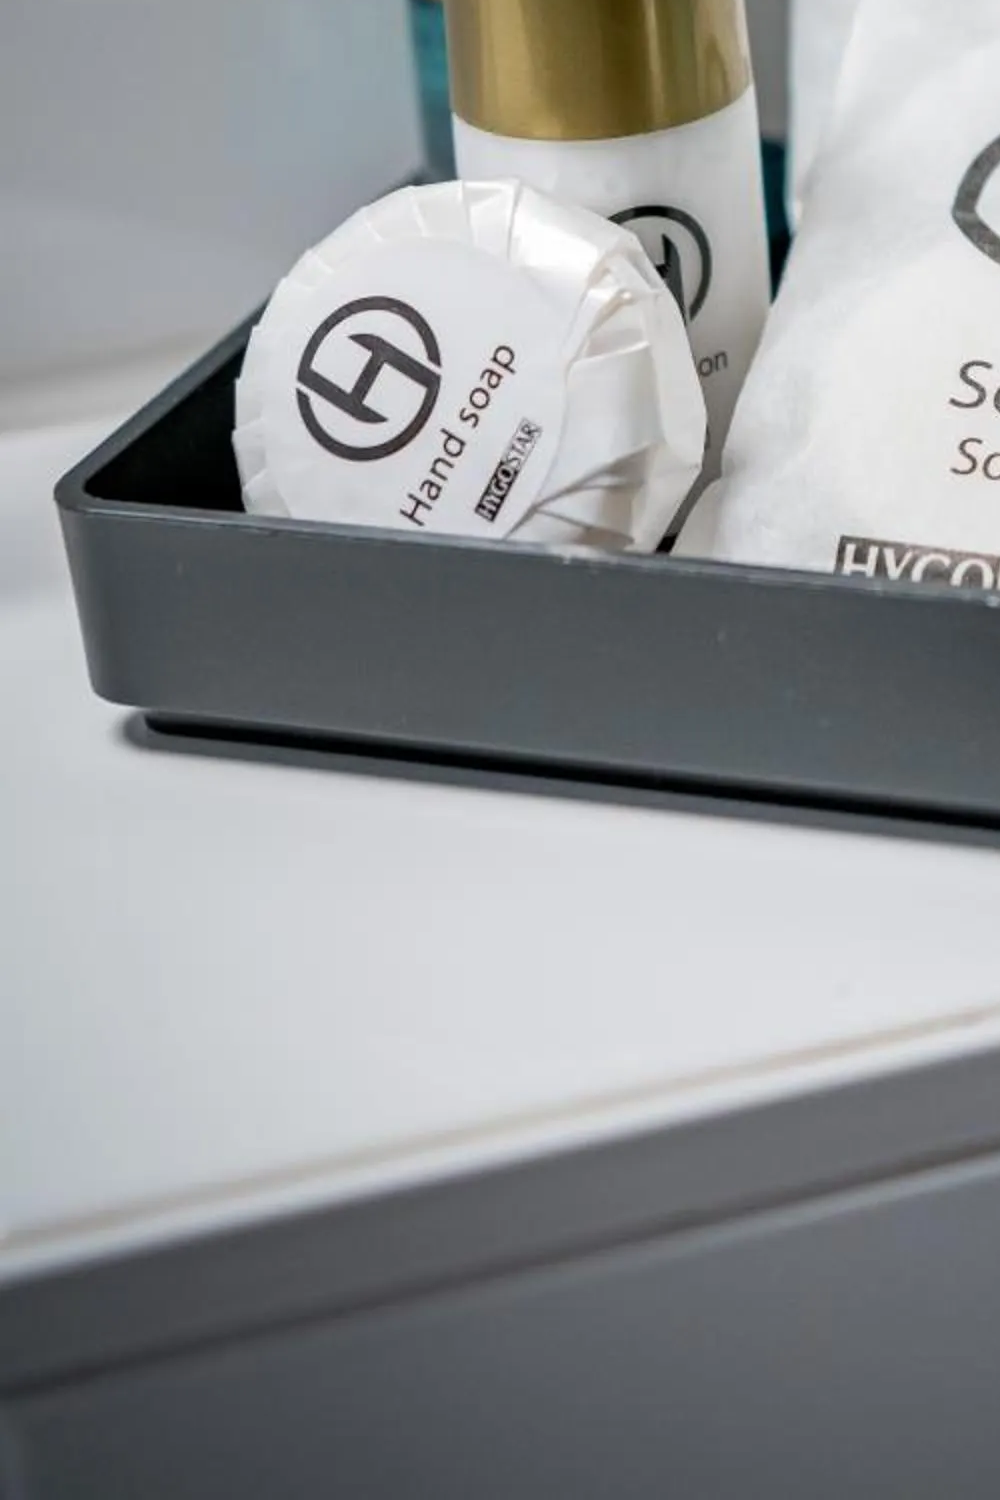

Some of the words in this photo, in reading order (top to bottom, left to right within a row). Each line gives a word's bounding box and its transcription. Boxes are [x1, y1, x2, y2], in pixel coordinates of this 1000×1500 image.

[399, 428, 466, 526] Hand
[459, 345, 516, 428] soap
[475, 418, 542, 522] HYGOSTAR
